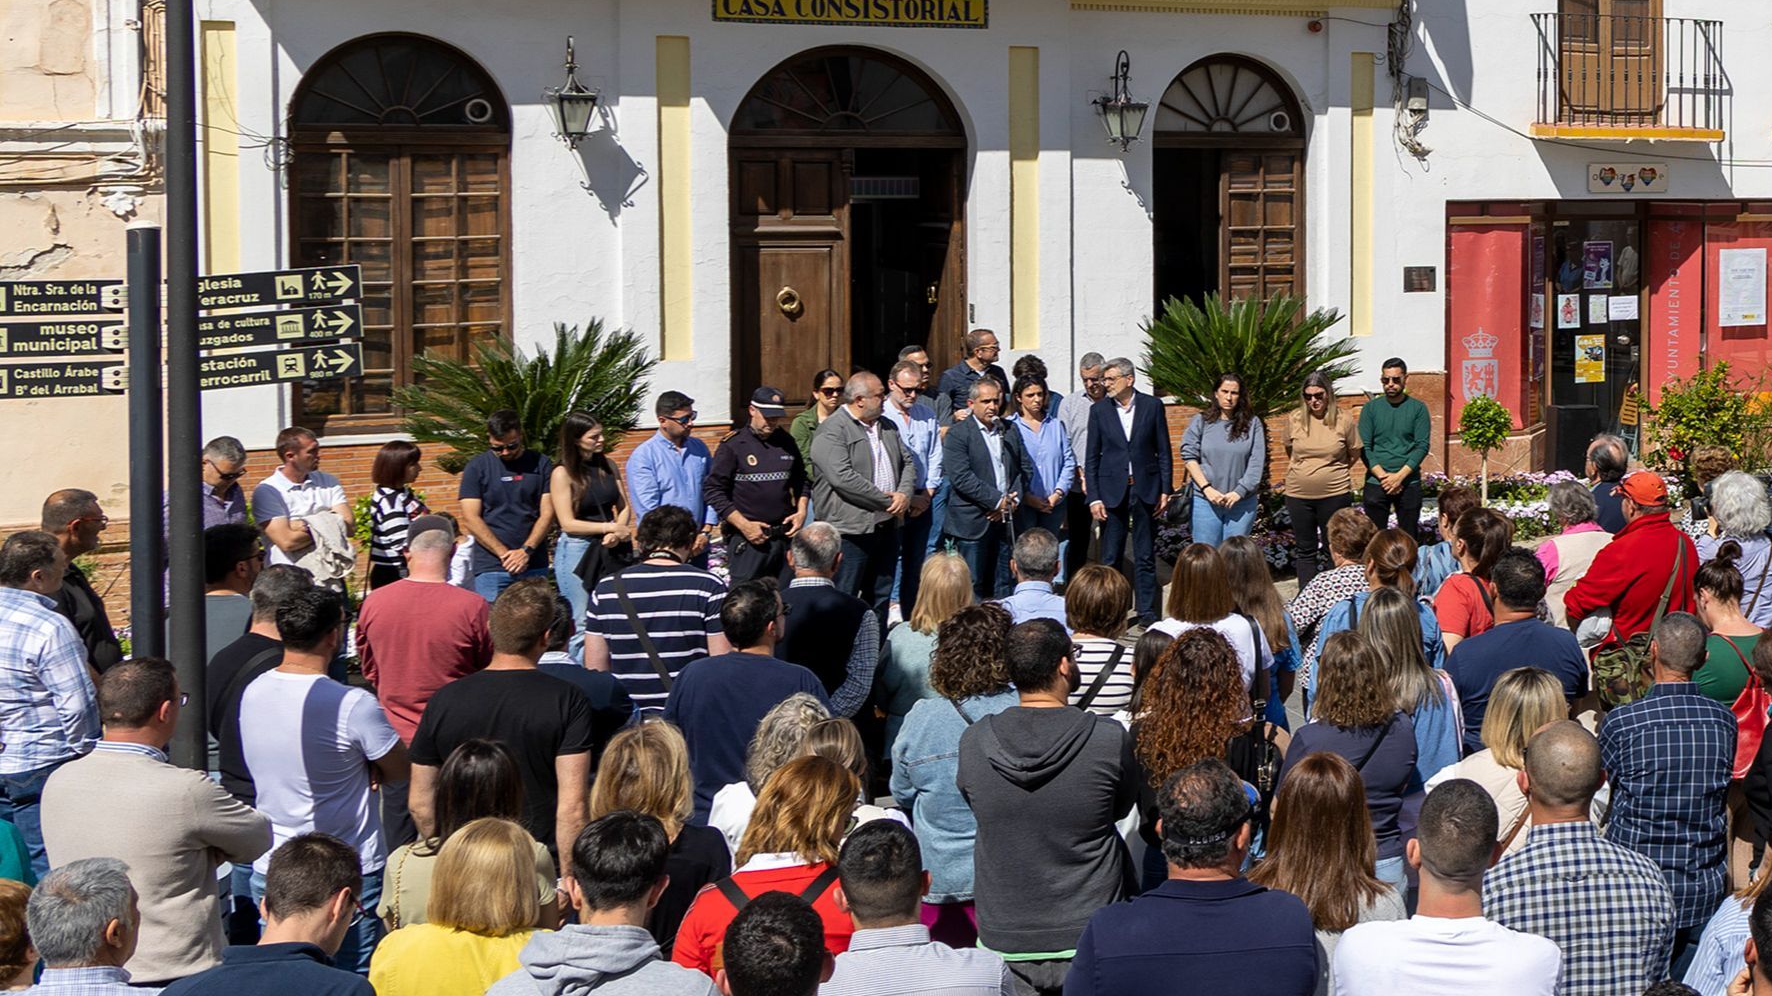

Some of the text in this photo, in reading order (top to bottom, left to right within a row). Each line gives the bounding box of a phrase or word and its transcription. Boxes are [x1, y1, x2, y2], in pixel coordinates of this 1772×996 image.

[13, 283, 97, 296] Ntra. Sra. de la
[198, 277, 243, 292] glesia
[13, 300, 98, 312] Encarnación
[198, 293, 260, 306] eracruz
[217, 320, 231, 329] de
[234, 316, 271, 328] cultura
[40, 324, 98, 335] museo
[13, 338, 98, 353] municipal
[199, 333, 254, 346] uzgados
[200, 357, 257, 372] stación
[14, 365, 99, 379] Castillo Árabe
[200, 370, 272, 386] errocarril
[30, 385, 50, 395] del
[53, 384, 98, 394] Arrabal
